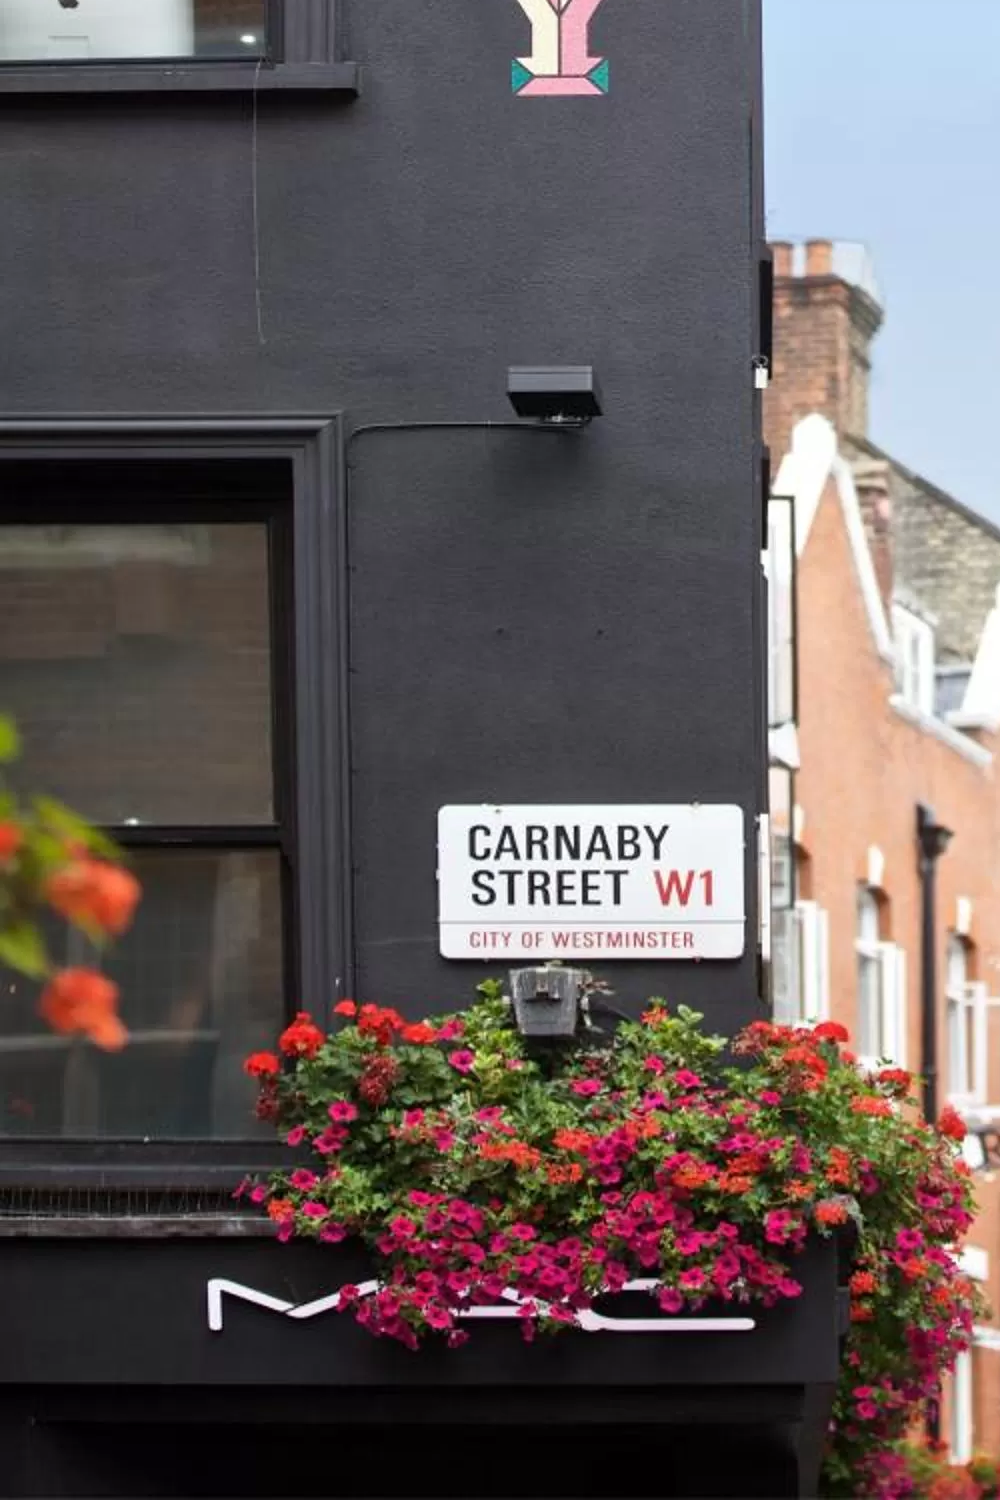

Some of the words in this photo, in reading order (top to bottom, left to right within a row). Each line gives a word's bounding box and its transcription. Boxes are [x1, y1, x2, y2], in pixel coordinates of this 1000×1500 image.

[467, 825, 670, 861] CARNABY
[471, 870, 629, 906] STREET
[653, 870, 714, 906] W1
[469, 931, 512, 949] CITY
[521, 931, 545, 949] OF
[551, 931, 695, 949] WESTMINSTER
